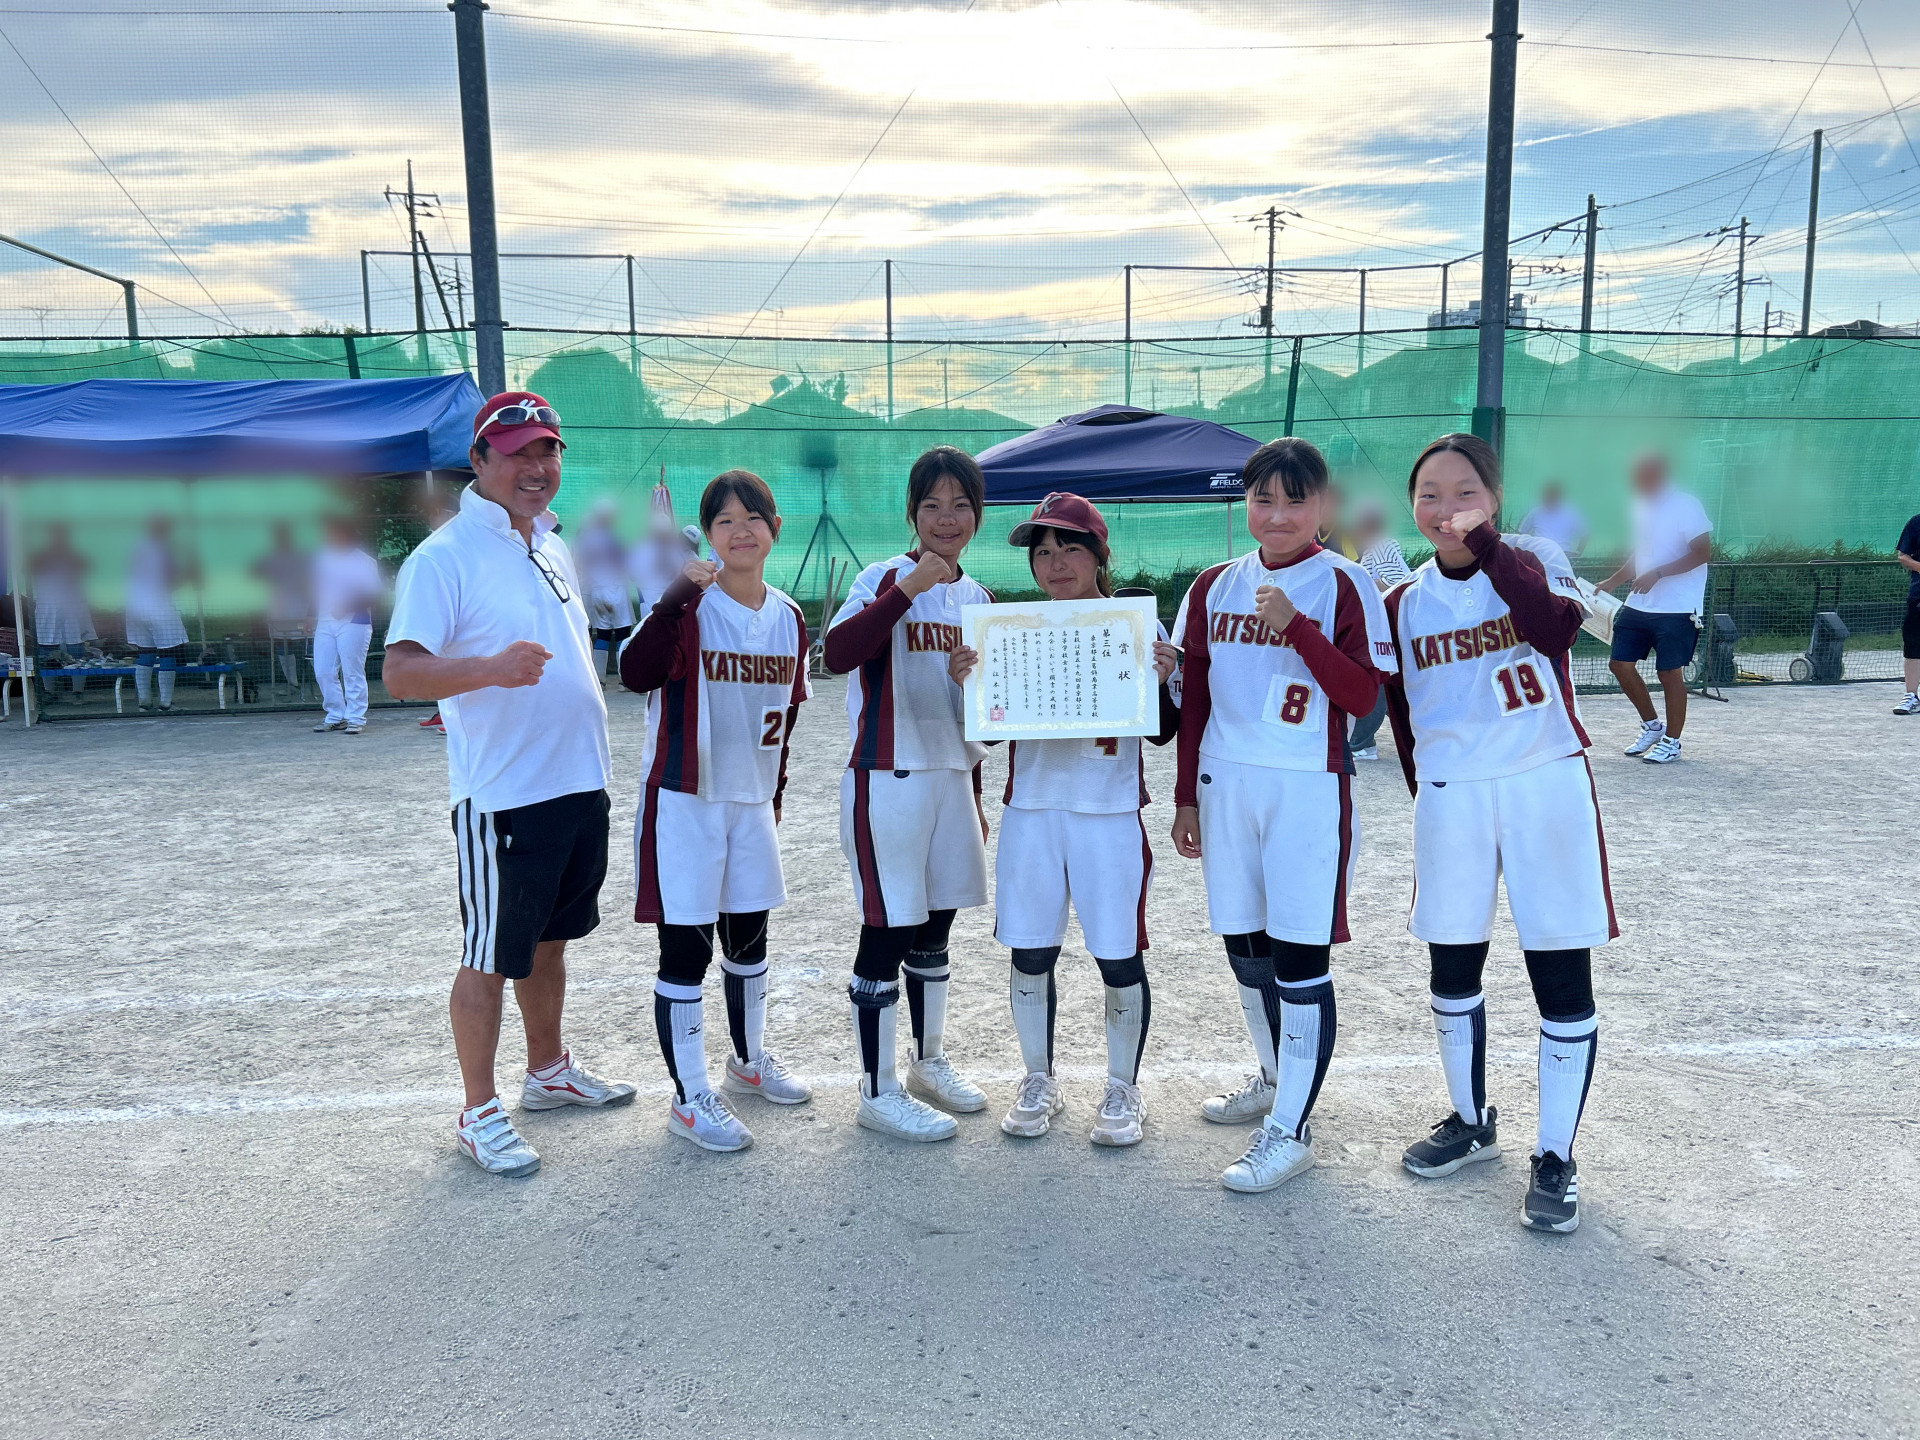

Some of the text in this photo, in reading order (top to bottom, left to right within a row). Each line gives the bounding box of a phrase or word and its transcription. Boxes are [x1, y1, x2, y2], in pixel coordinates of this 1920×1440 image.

[1102, 628, 1112, 657] 第三位
[700, 649, 796, 686] KATSUSHO
[1279, 682, 1312, 726] 8
[1496, 662, 1547, 712] 19
[760, 710, 788, 747] 2
